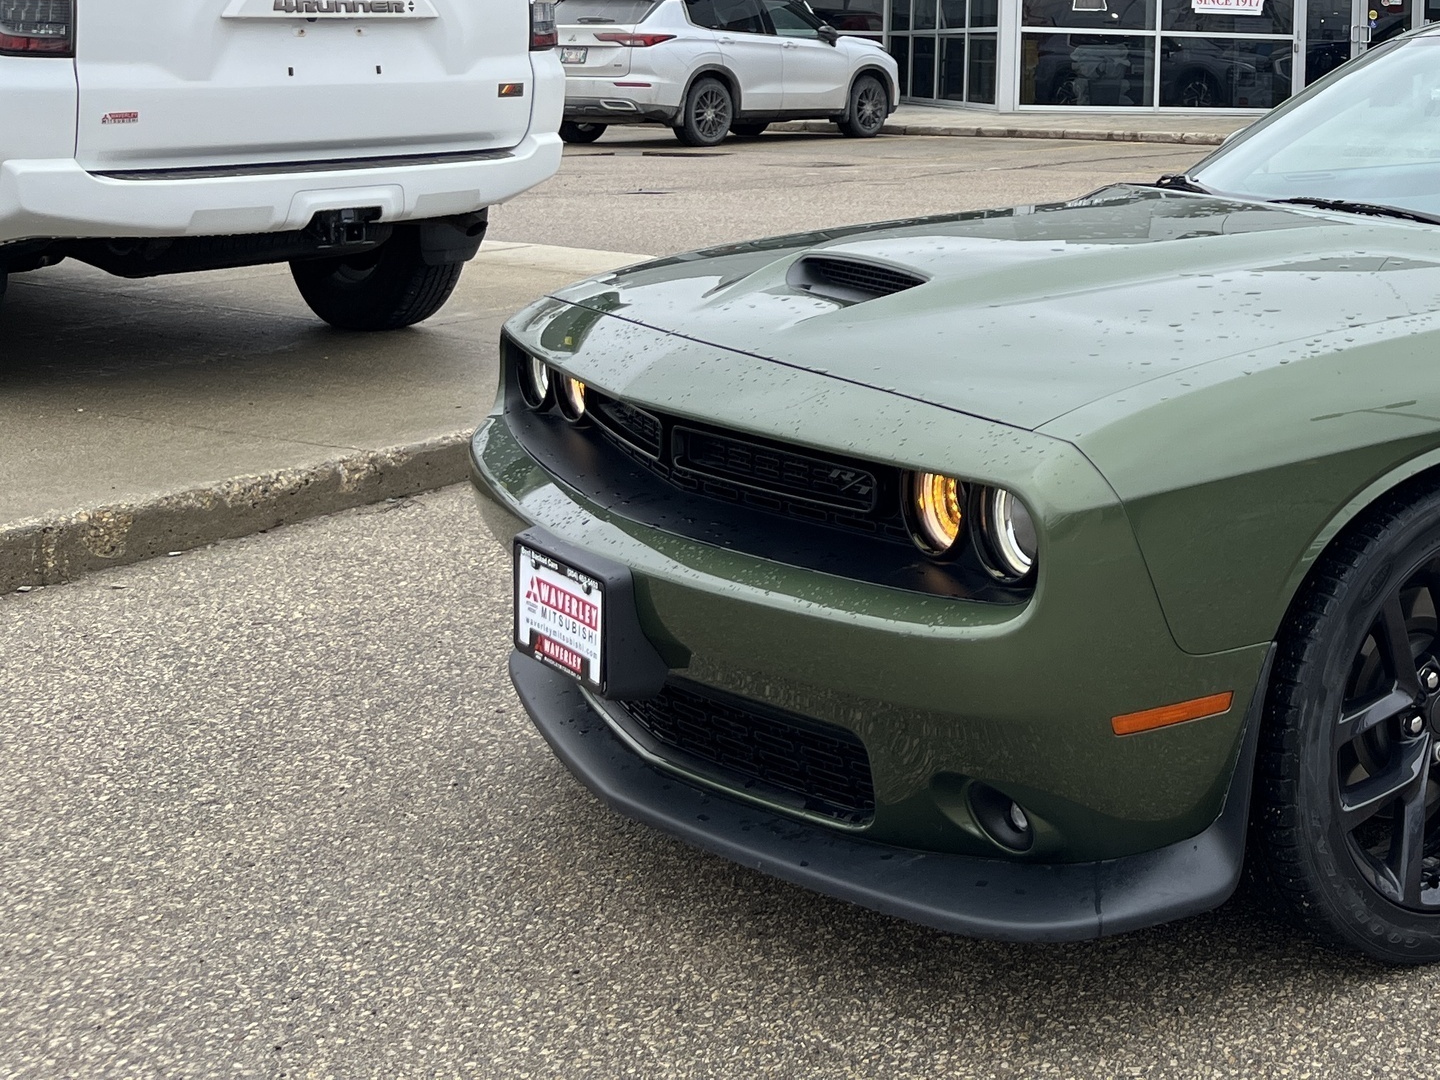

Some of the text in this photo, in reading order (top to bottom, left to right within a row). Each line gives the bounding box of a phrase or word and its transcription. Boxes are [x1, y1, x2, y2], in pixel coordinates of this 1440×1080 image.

[829, 468, 871, 495] R/T
[540, 581, 598, 627] WAVERLEY
[541, 606, 598, 646] MITSUBISHI
[544, 639, 582, 670] WAVERLEY
